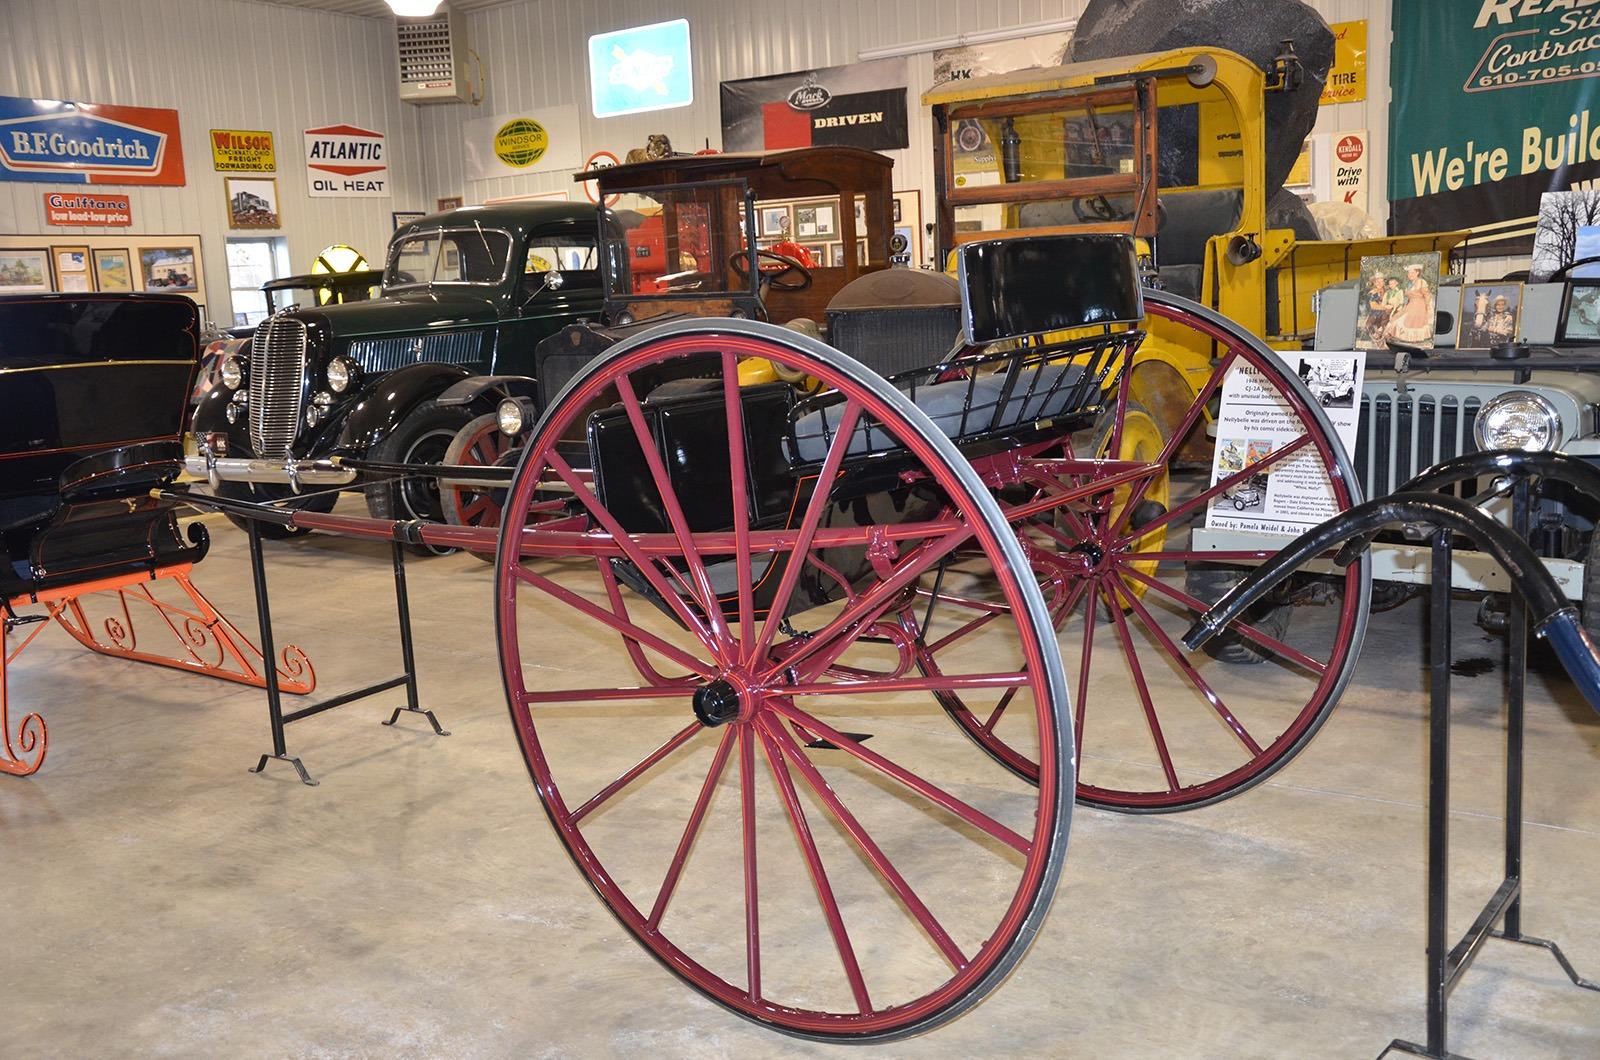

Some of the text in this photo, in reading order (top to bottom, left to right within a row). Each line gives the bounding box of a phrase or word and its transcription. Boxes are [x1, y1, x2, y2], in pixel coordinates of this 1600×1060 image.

[1332, 72, 1357, 85] TIRE
[1479, 61, 1600, 86] 610-705-0
[794, 89, 825, 106] Mack
[1320, 86, 1356, 99] ervice
[814, 112, 883, 129] DRIVEN
[213, 132, 271, 150] WILSON
[499, 134, 542, 146] WINDSOR
[310, 141, 382, 160] ATLANTIC
[1338, 144, 1361, 153] KENDALL
[1337, 167, 1362, 177] Drive
[1411, 141, 1509, 197] We're
[313, 181, 384, 191] OIL HEAT
[1337, 176, 1359, 186] with
[50, 195, 126, 210] Gulftane
[1344, 190, 1358, 204] K
[51, 211, 69, 221] low
[108, 212, 128, 223] price
[1211, 520, 1228, 528] Owned
[1229, 521, 1237, 530] by:
[1240, 522, 1258, 530] Pamela
